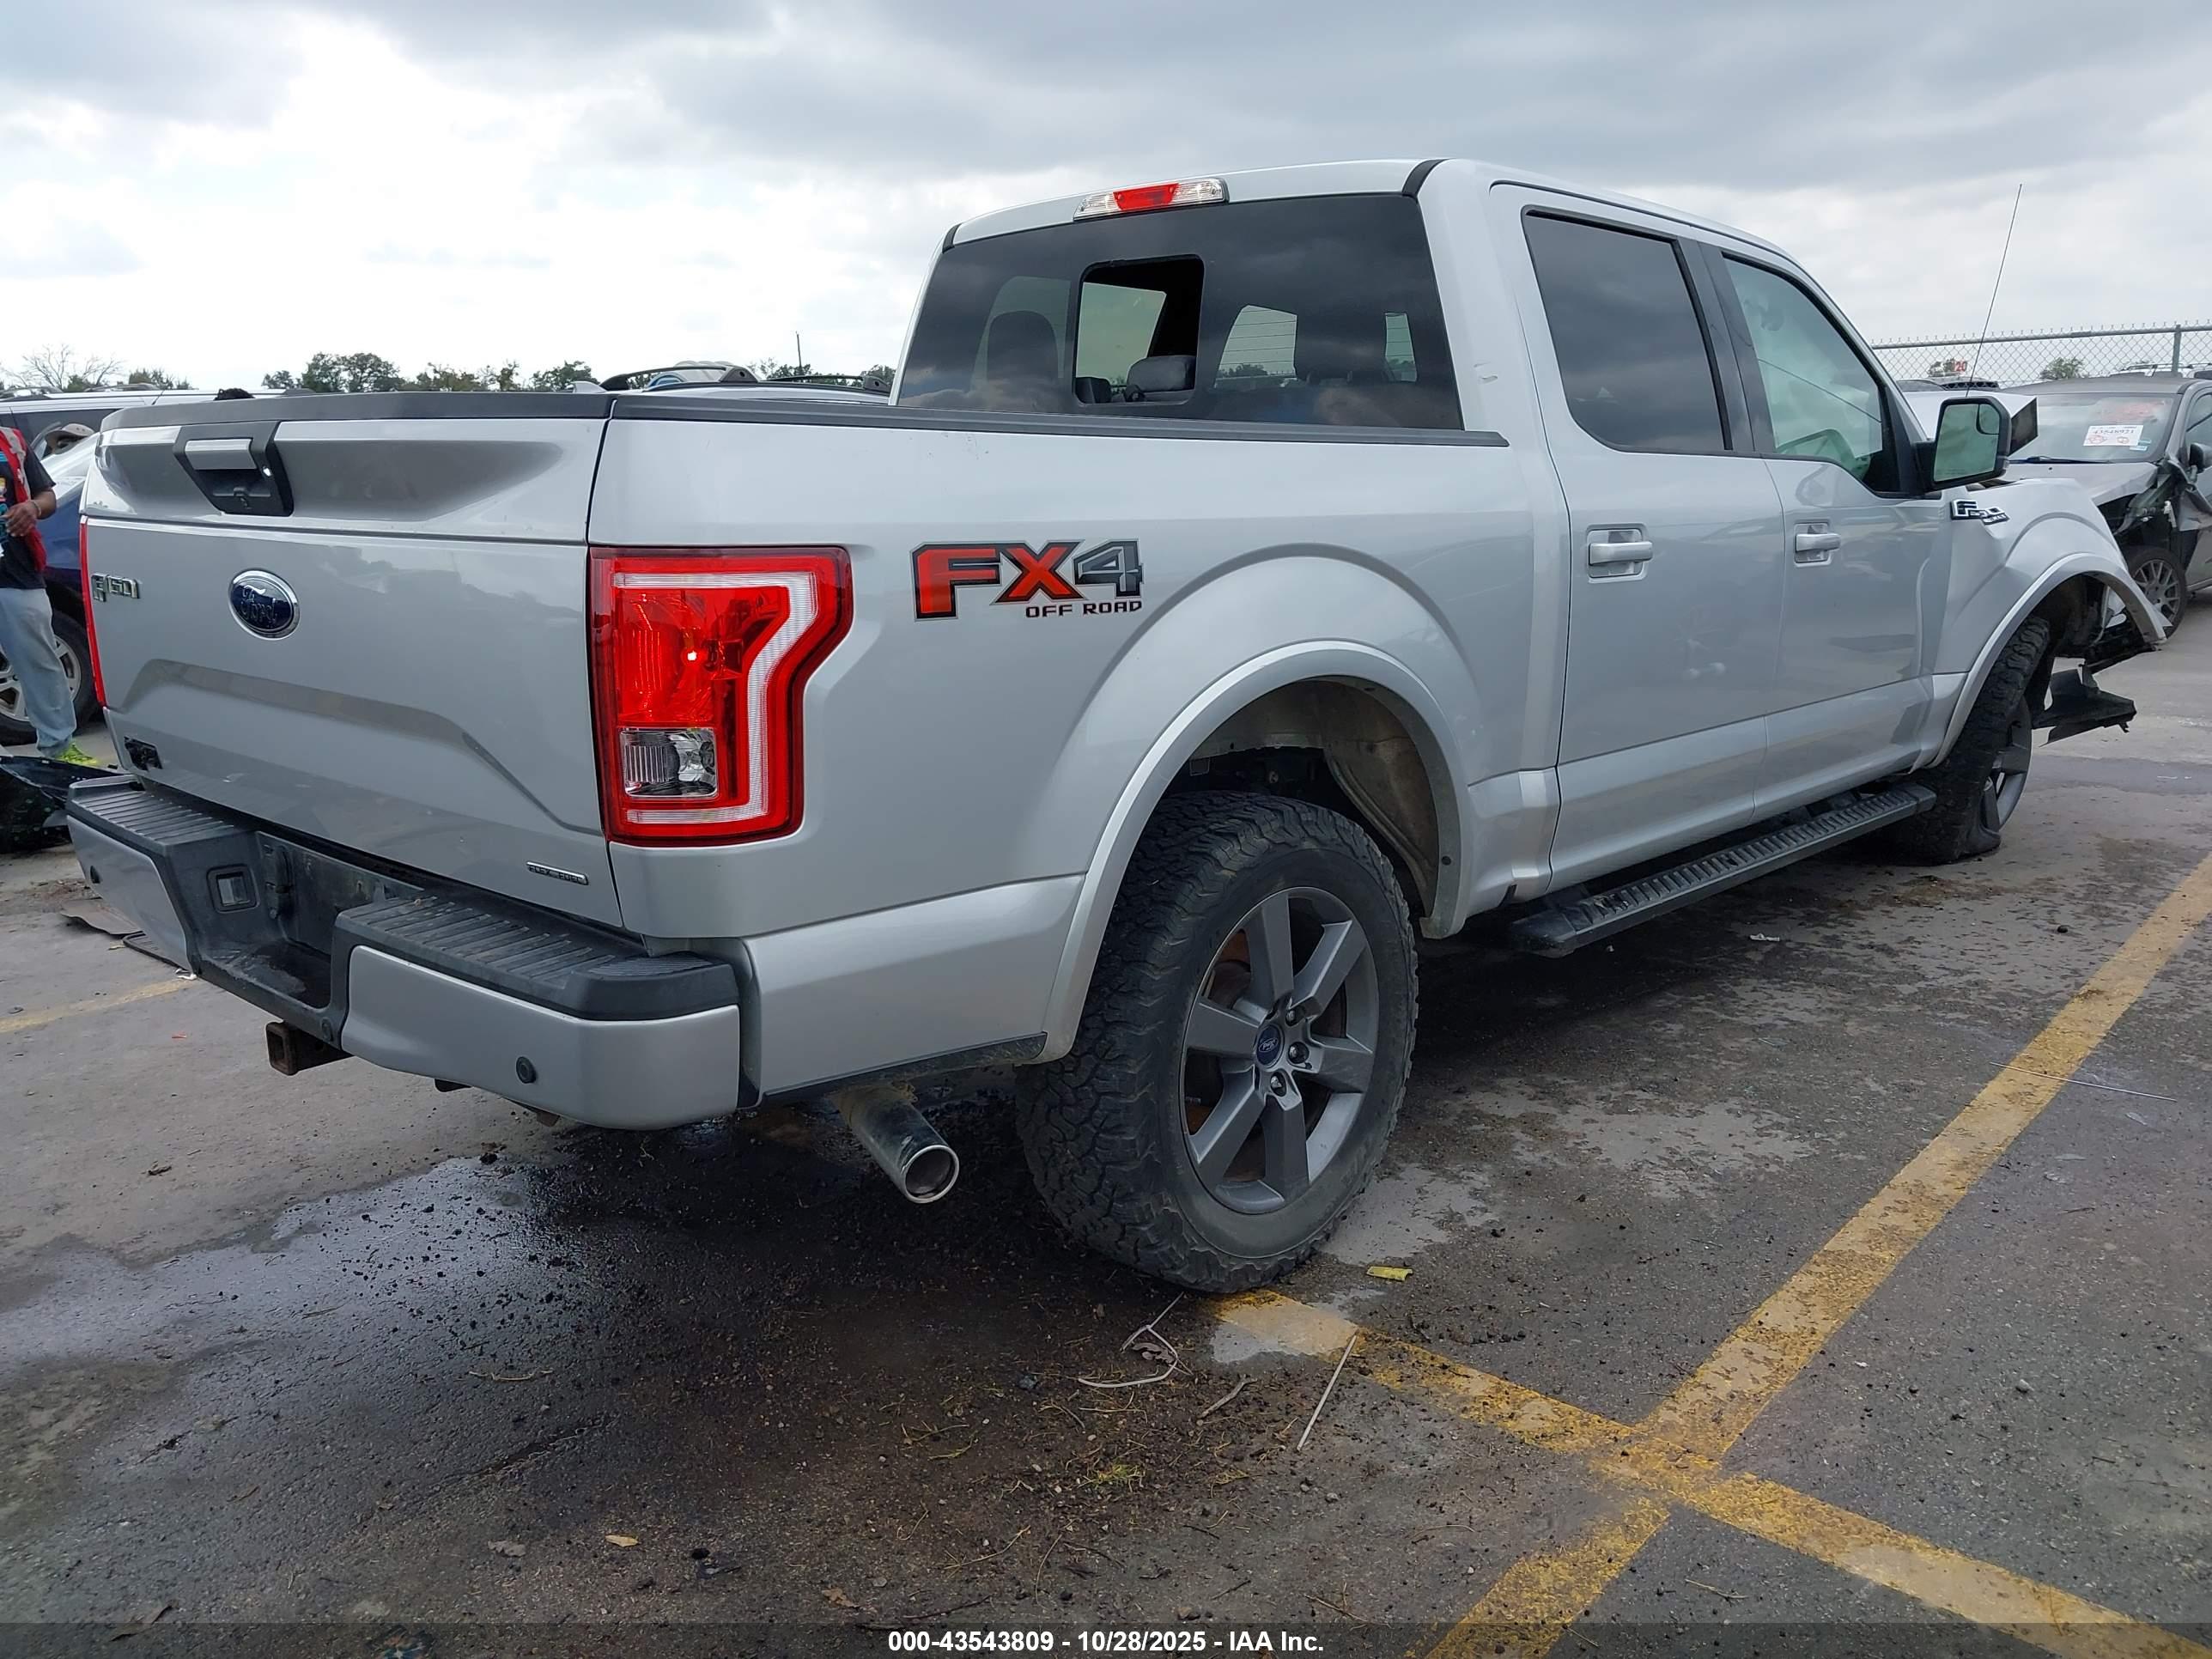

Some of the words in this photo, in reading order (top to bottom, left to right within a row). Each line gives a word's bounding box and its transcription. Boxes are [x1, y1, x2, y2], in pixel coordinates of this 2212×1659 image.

[910, 539, 1143, 621] FX4
[1025, 604, 1073, 617] OFF
[1083, 601, 1143, 616] ROAD
